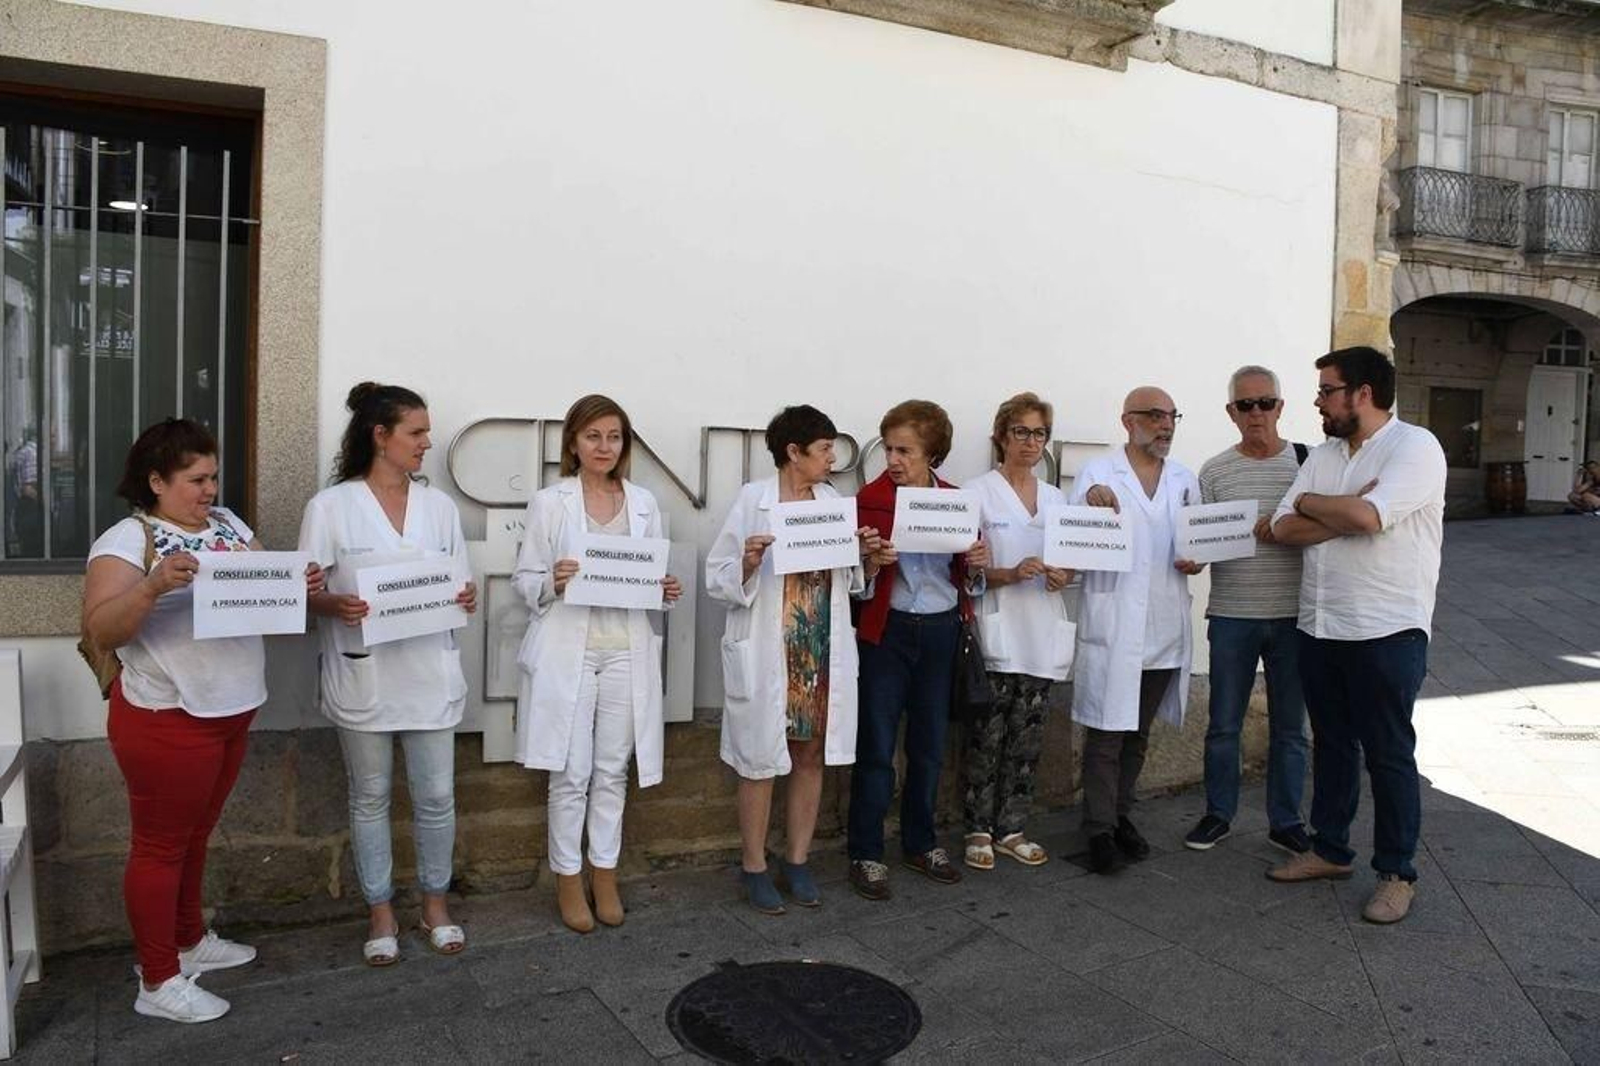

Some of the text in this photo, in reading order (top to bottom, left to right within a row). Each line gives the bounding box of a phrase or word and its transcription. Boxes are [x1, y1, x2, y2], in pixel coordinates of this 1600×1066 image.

[1060, 518, 1103, 528] CONSELLEIRO
[943, 526, 956, 534] NON
[1065, 540, 1094, 548] PRIMARIA
[1096, 541, 1109, 549] NON
[1110, 543, 1127, 551] CALA
[585, 549, 635, 562] CONSELLEIRO
[213, 569, 270, 580] CONSELLEIRO
[590, 574, 624, 583] PRIMARIA
[624, 577, 641, 585] NON
[641, 577, 659, 586] CALA
[377, 576, 430, 592] CONSELLEIRO
[212, 597, 298, 608] A PRIMARIA NON CALA
[379, 609, 386, 617] A
[386, 603, 422, 615] PRIMARIA
[423, 600, 441, 610] NON
